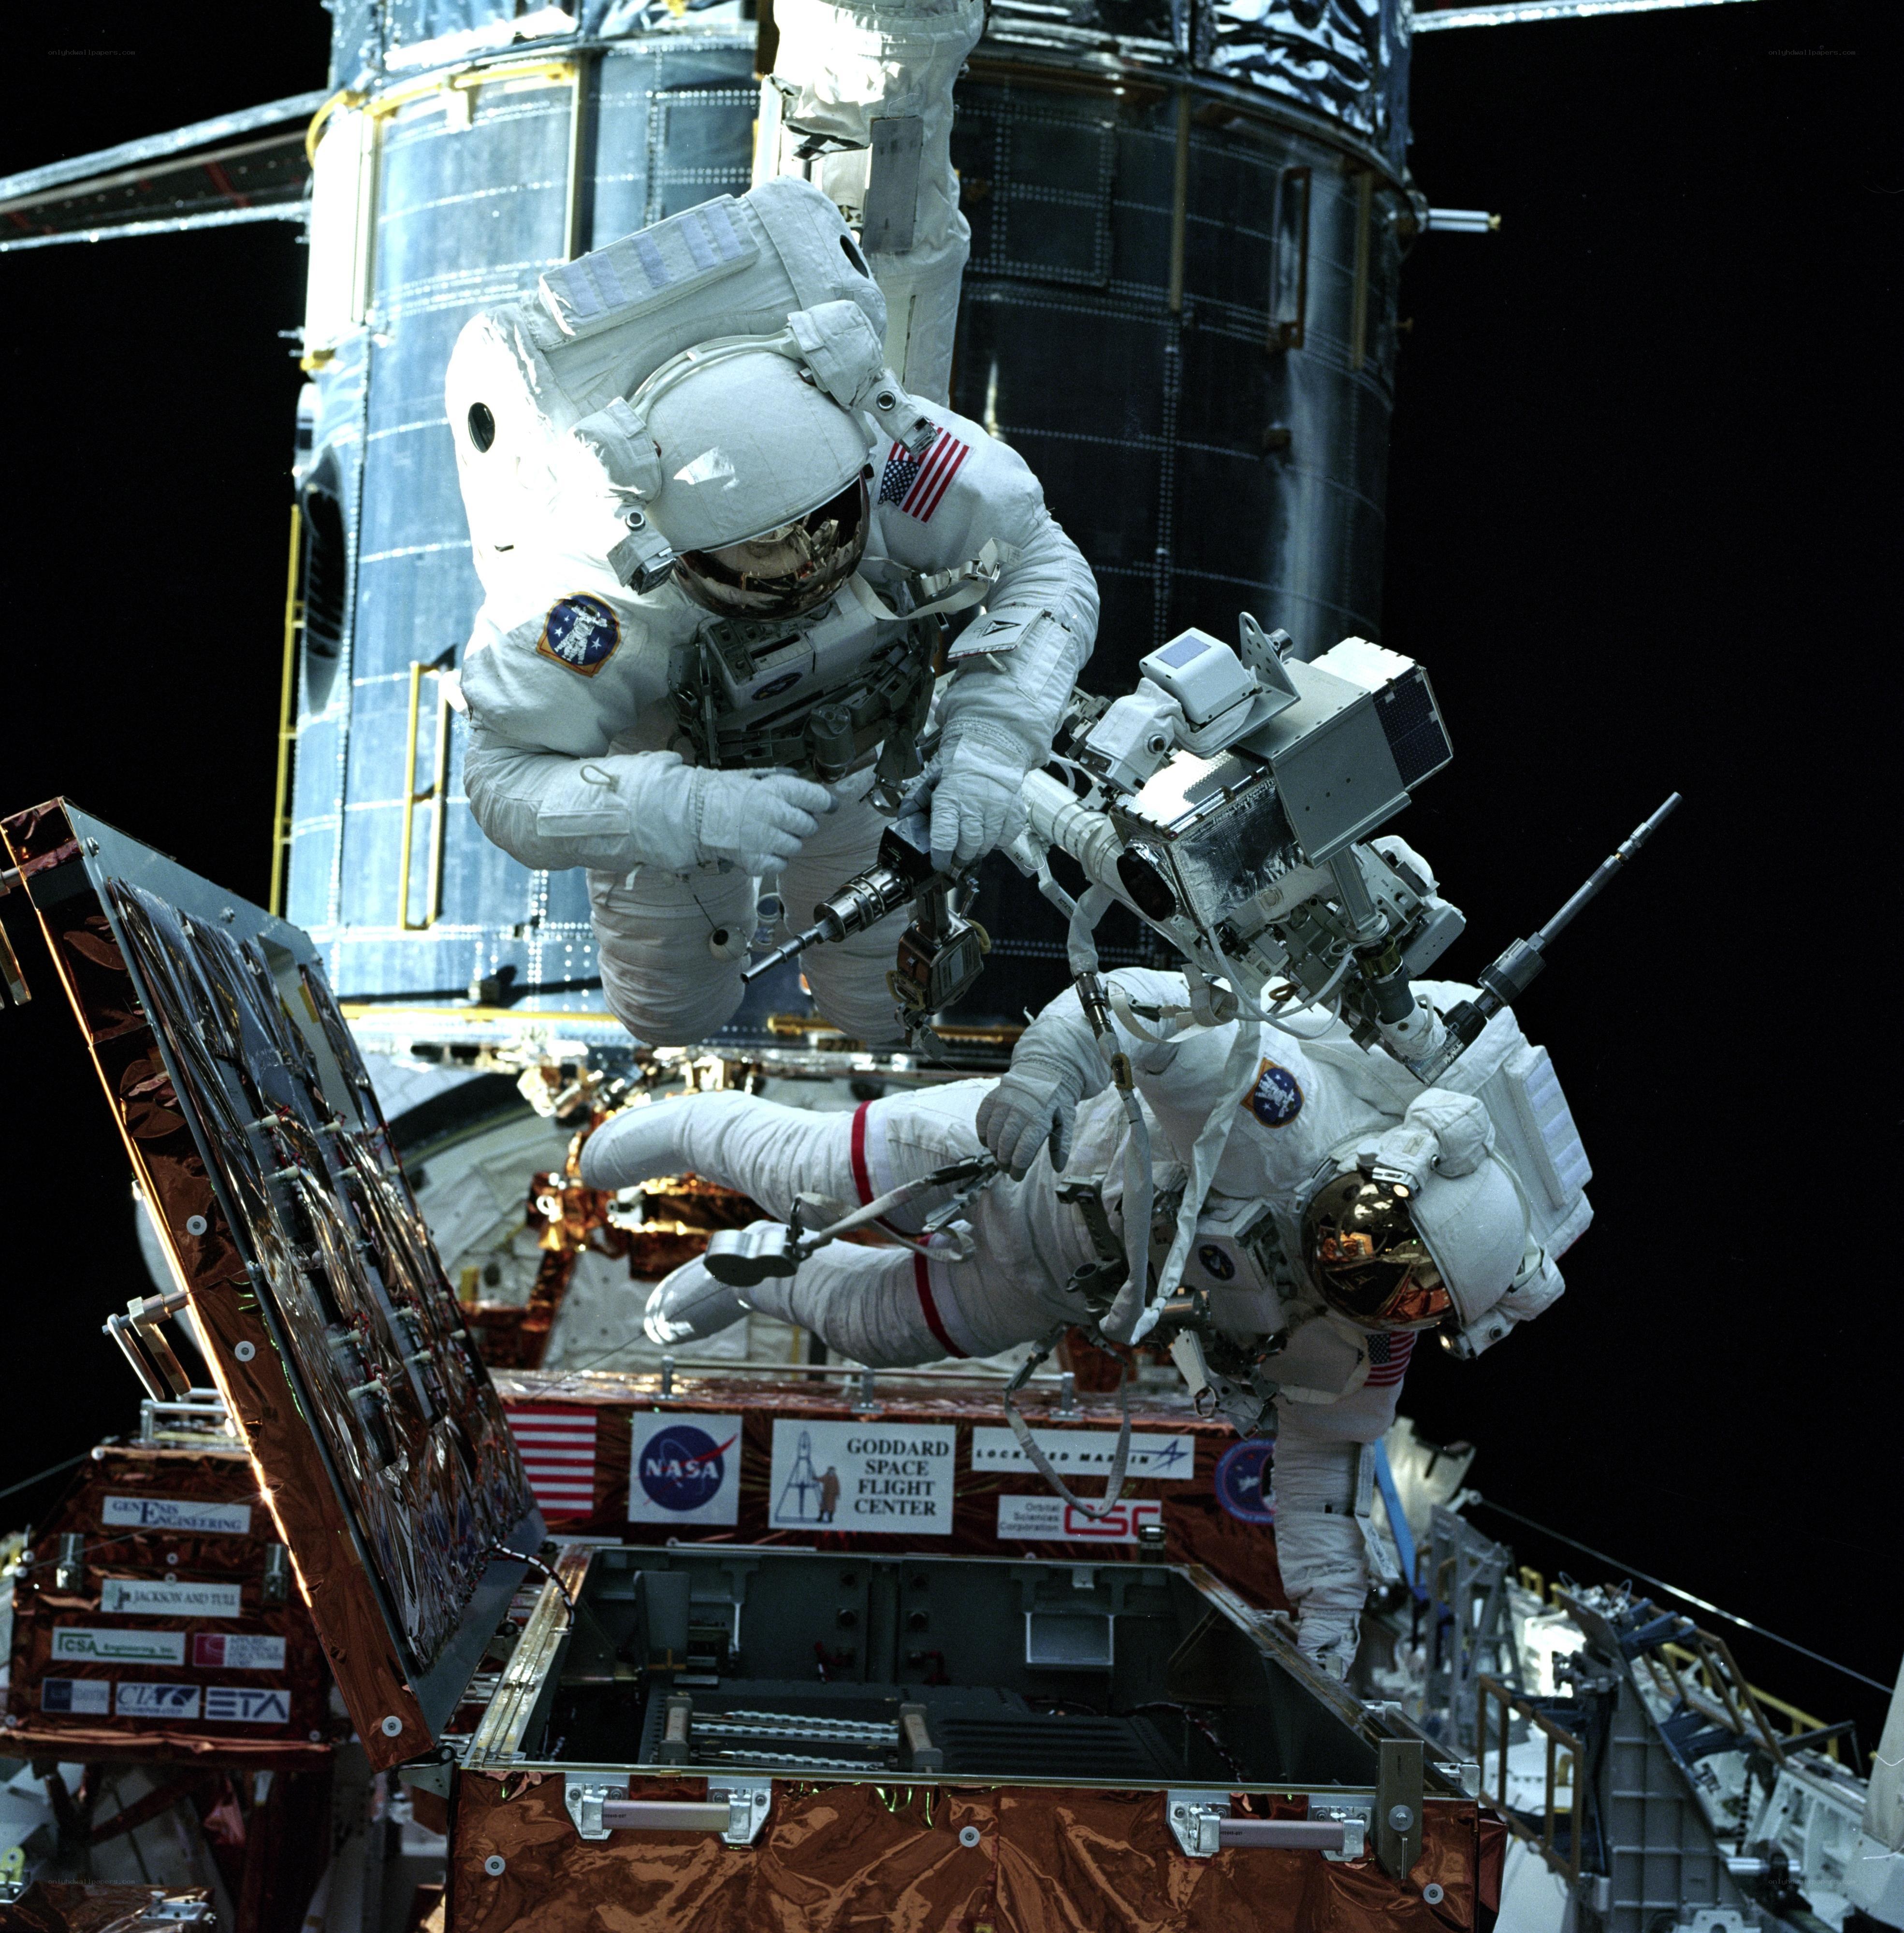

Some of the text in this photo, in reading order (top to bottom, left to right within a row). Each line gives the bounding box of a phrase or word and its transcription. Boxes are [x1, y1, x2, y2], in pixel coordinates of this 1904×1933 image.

[847, 1438, 949, 1457] GODDARD
[976, 1449, 1148, 1464] LOCKED MARIN
[645, 1459, 719, 1480] NASA
[864, 1458, 929, 1477] SPACE
[858, 1479, 935, 1496] FLIGHT
[854, 1498, 936, 1516] CENTER
[1025, 1502, 1060, 1512] Orbital
[1014, 1512, 1059, 1522] Sciences
[999, 1522, 1059, 1533] Corporation
[134, 1590, 182, 1604] JACKSON
[184, 1593, 209, 1604] AND
[64, 1639, 96, 1653] CSA
[208, 1690, 287, 1718] ETA
